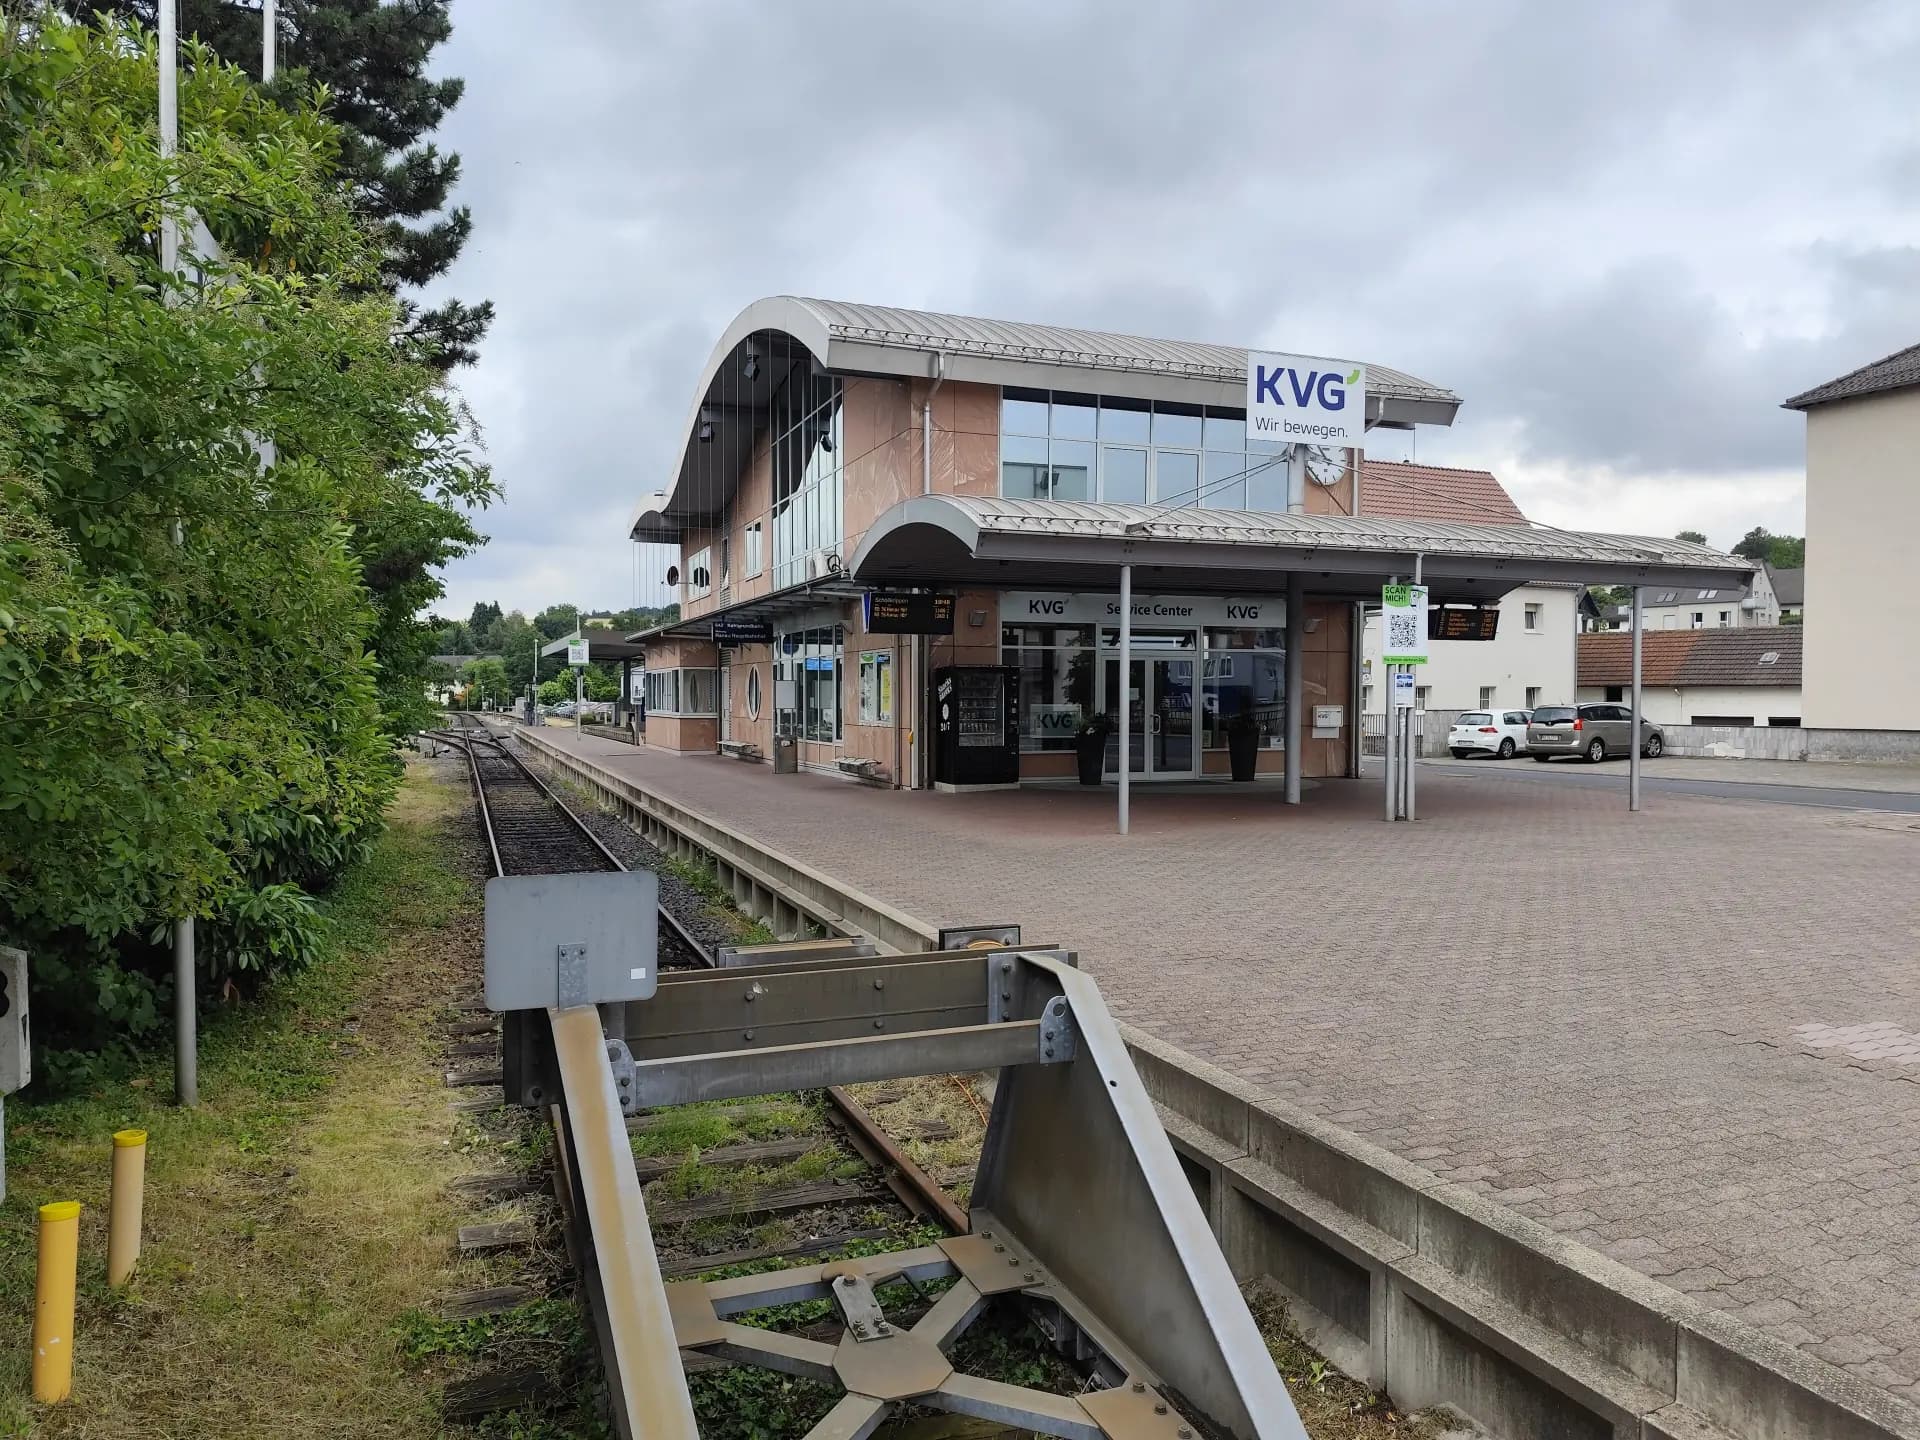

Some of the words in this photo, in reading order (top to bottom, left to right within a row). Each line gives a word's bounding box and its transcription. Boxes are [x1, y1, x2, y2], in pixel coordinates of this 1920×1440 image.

[1256, 365, 1345, 411] KVG
[1255, 416, 1280, 432] Wir
[1284, 418, 1349, 439] bewegen.
[1385, 586, 1406, 594] SCAN
[1029, 599, 1064, 614] KVG
[1106, 602, 1151, 615] Sevice
[1153, 604, 1193, 616] Center
[1227, 605, 1259, 619] KVG
[1037, 713, 1073, 729] KVG
